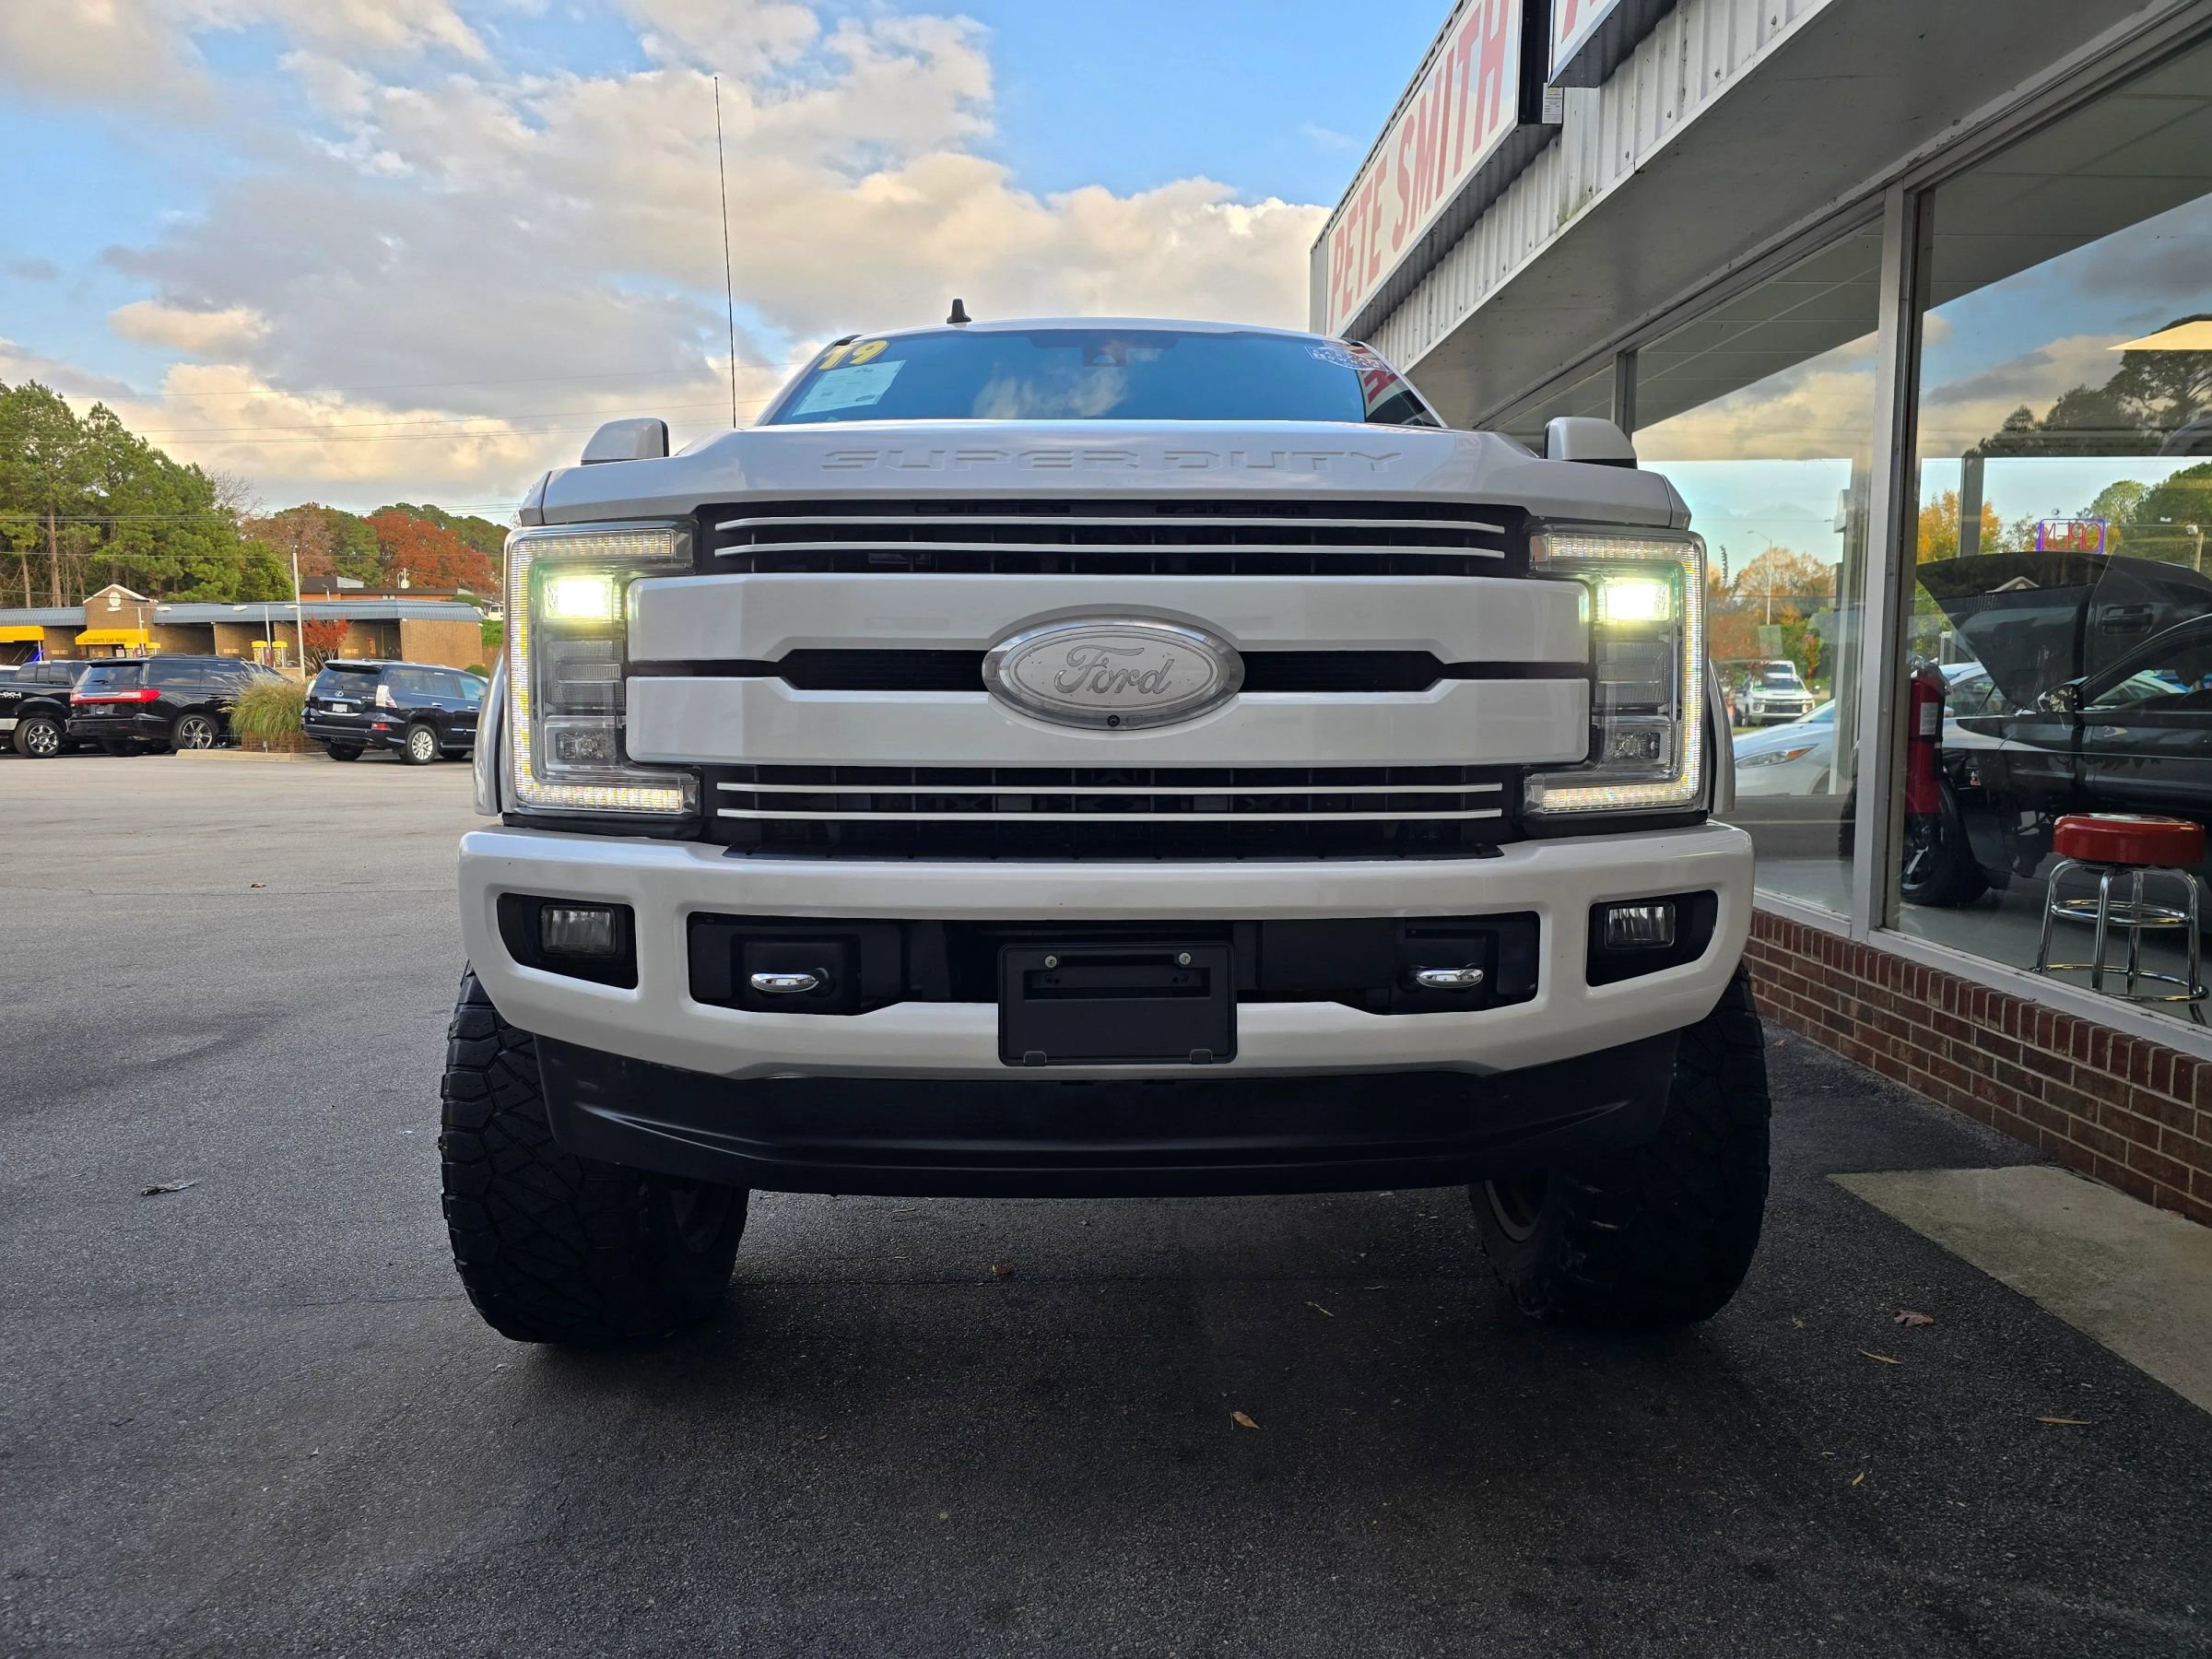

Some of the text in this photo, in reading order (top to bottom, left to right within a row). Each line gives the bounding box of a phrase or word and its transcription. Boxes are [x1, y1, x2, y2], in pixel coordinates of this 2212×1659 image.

[1329, 154, 1387, 337] PETE
[1393, 0, 1509, 253] SMITH
[818, 339, 889, 371] 19
[820, 450, 1402, 473] SUPER DUTY
[1053, 644, 1175, 695] Ford
